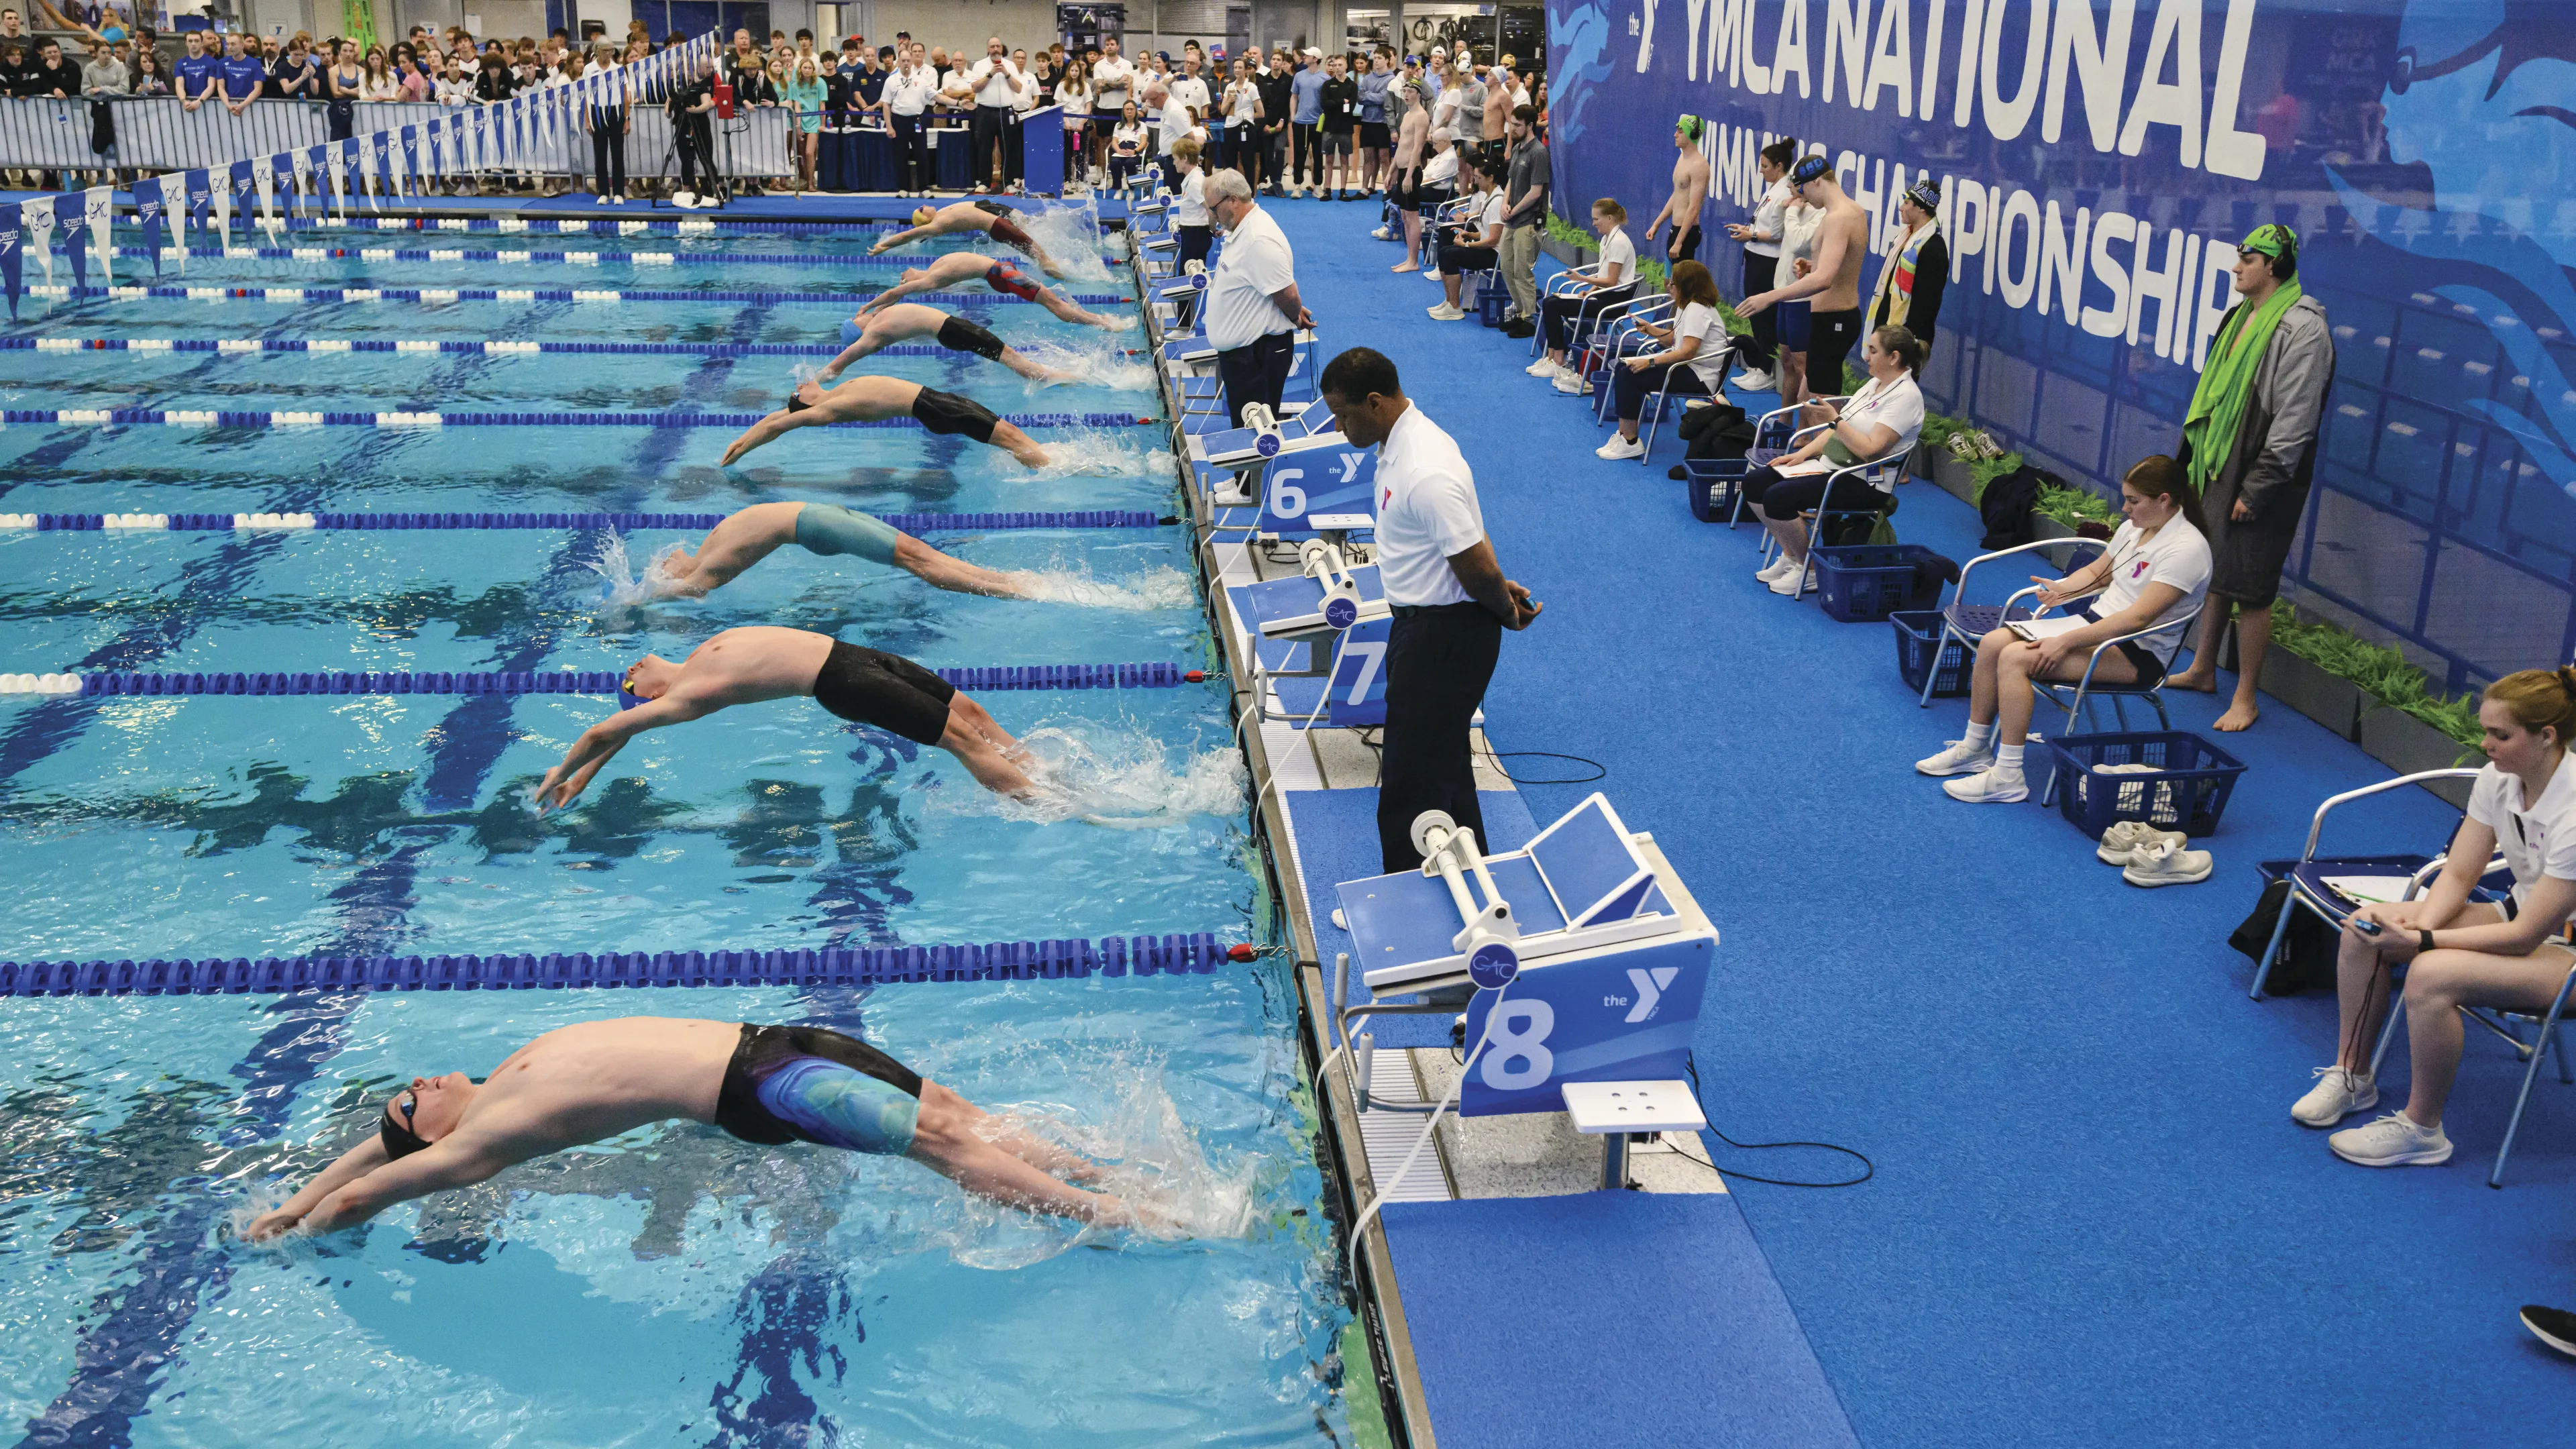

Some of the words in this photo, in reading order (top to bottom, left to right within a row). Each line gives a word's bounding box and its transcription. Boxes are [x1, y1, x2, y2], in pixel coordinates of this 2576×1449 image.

[1629, 11, 1640, 36] the
[1688, 0, 1810, 99] YMCA
[140, 200, 160, 213] speedo
[63, 215, 84, 229] speedo
[0, 227, 19, 244] peedo
[1270, 468, 1307, 519] 6
[1344, 641, 1388, 706] 7
[1603, 994, 1627, 1007] the
[1646, 1006, 1660, 1021] YMCA
[1481, 998, 1554, 1091] 8
